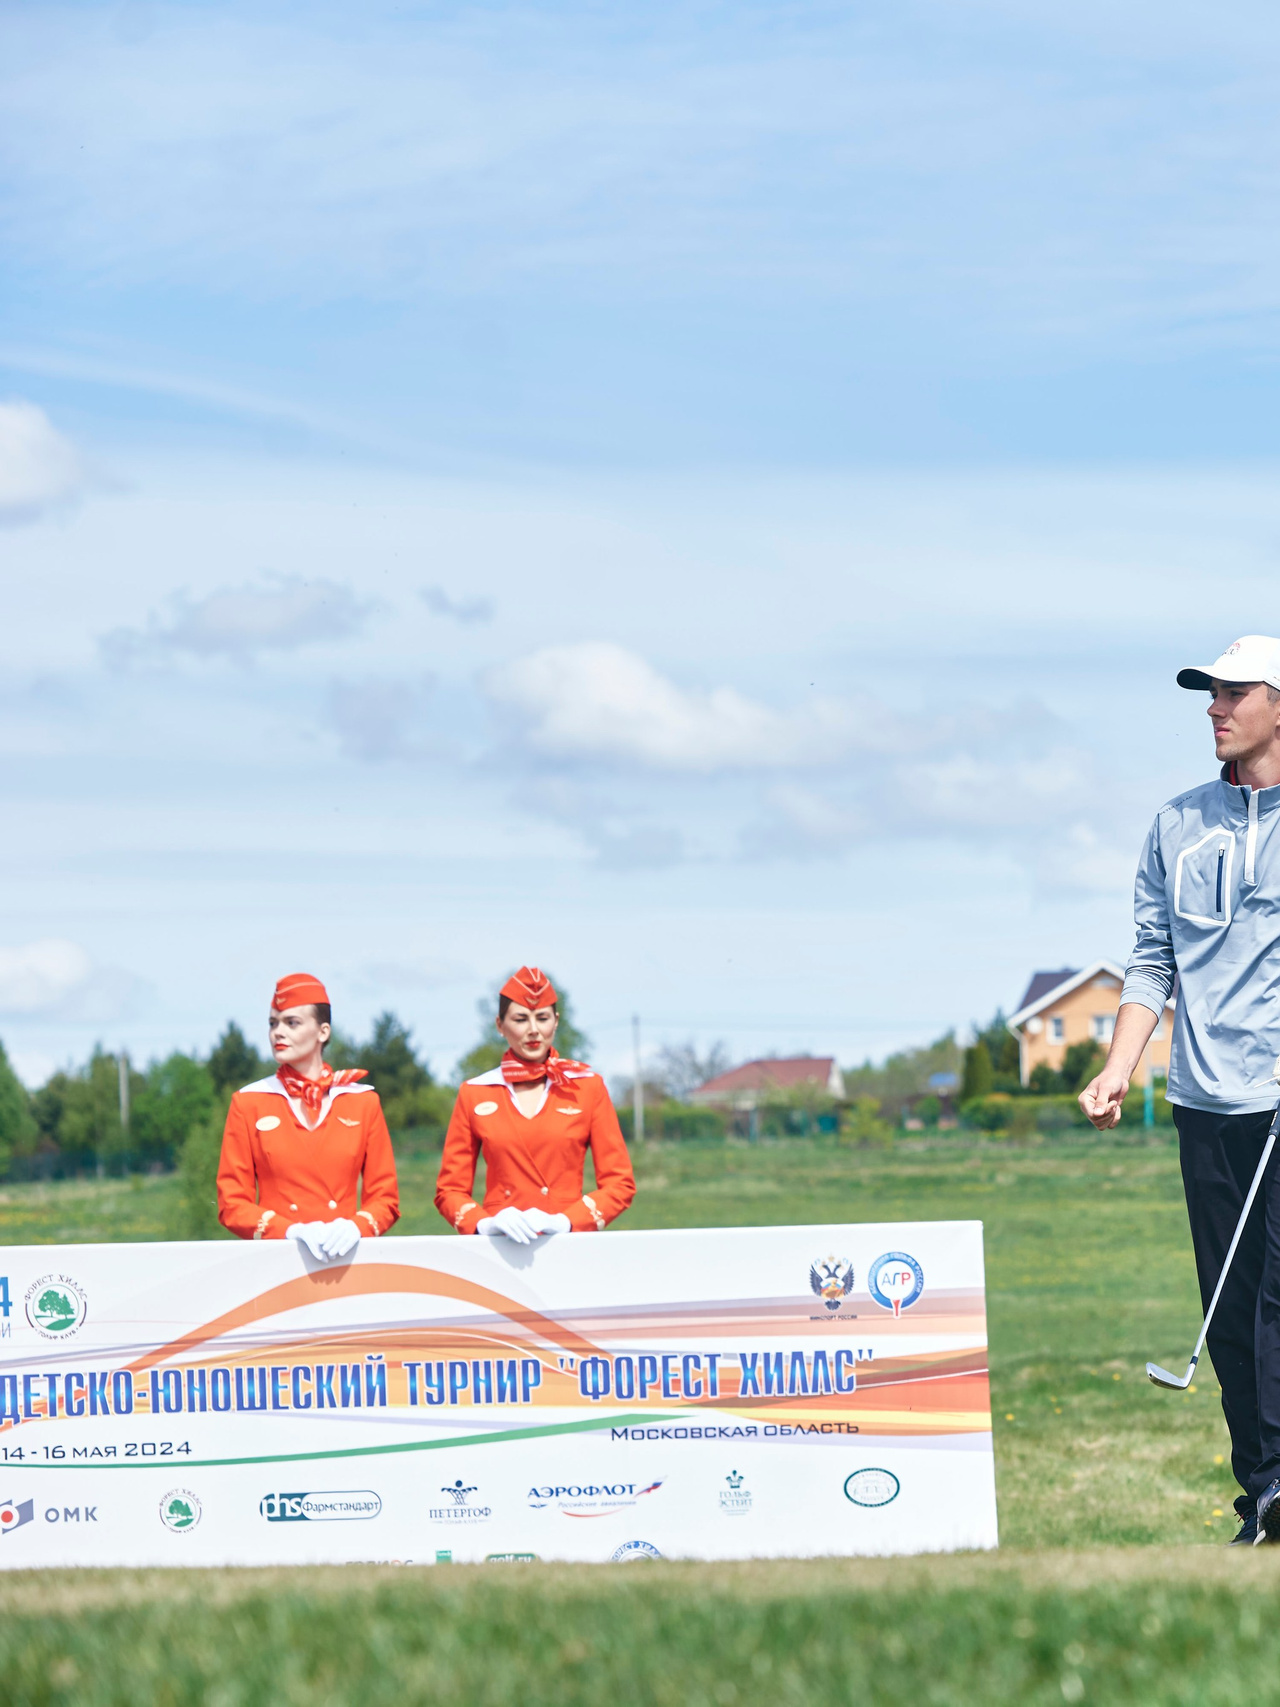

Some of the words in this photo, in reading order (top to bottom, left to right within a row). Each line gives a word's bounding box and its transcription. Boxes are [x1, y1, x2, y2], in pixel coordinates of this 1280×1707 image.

[881, 1272, 911, 1287] АГР
[25, 1274, 54, 1301] ФОРЕСТ
[0, 1355, 387, 1425] ДЕТСКО-ЮНОШЕСКИЙ
[403, 1359, 541, 1406] ТУРНИР
[558, 1354, 721, 1400] "ФОРЕСТ
[2, 1447, 25, 1460] 14
[43, 1445, 66, 1459] 16
[73, 1446, 117, 1459] МАЯ
[124, 1441, 192, 1456] 2024
[527, 1484, 637, 1498] АЭРОФЛОТ
[303, 1501, 379, 1513] Фармстандарт
[429, 1507, 492, 1518] ПЕТЕРГОФ
[45, 1507, 98, 1523] ОМК
